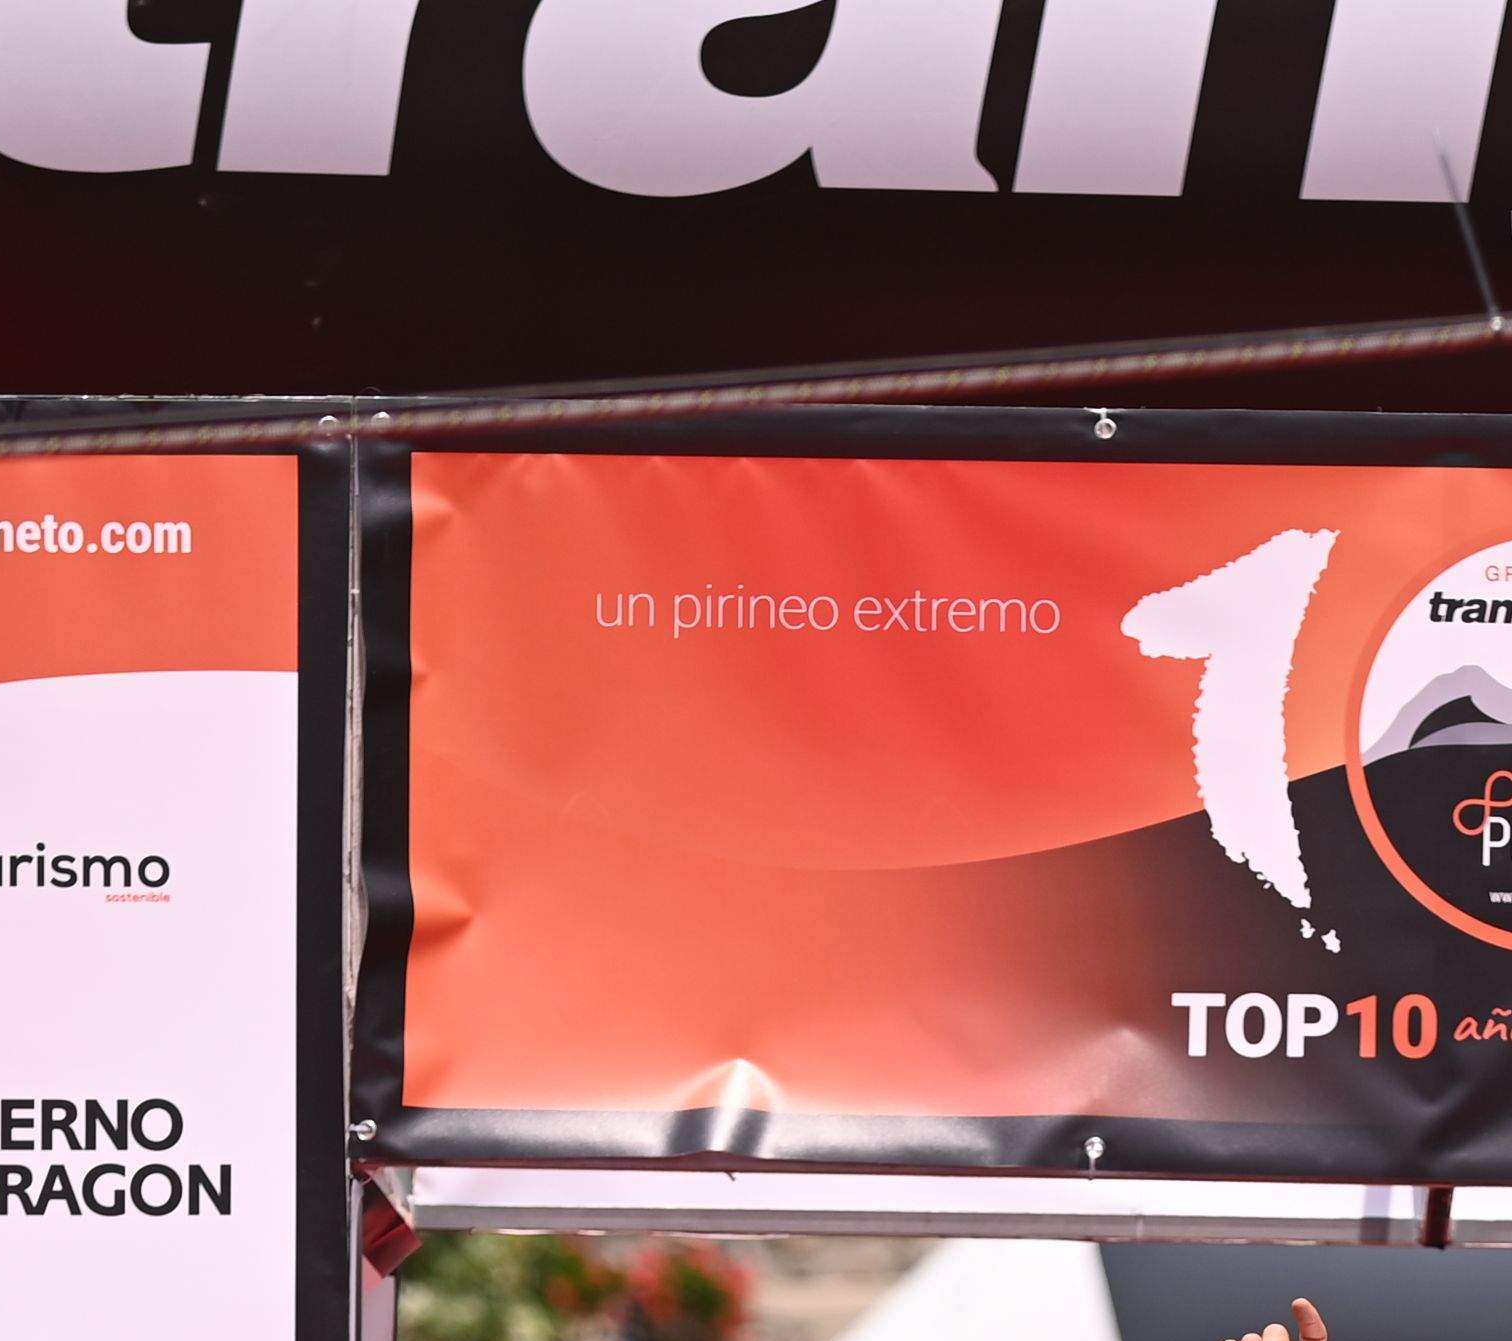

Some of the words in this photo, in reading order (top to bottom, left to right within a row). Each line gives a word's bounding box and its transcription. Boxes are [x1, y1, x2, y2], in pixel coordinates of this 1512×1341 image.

[595, 590, 655, 628] un
[674, 584, 839, 639] pirineo
[854, 589, 1062, 635] extremo
[105, 891, 172, 904] sostenible
